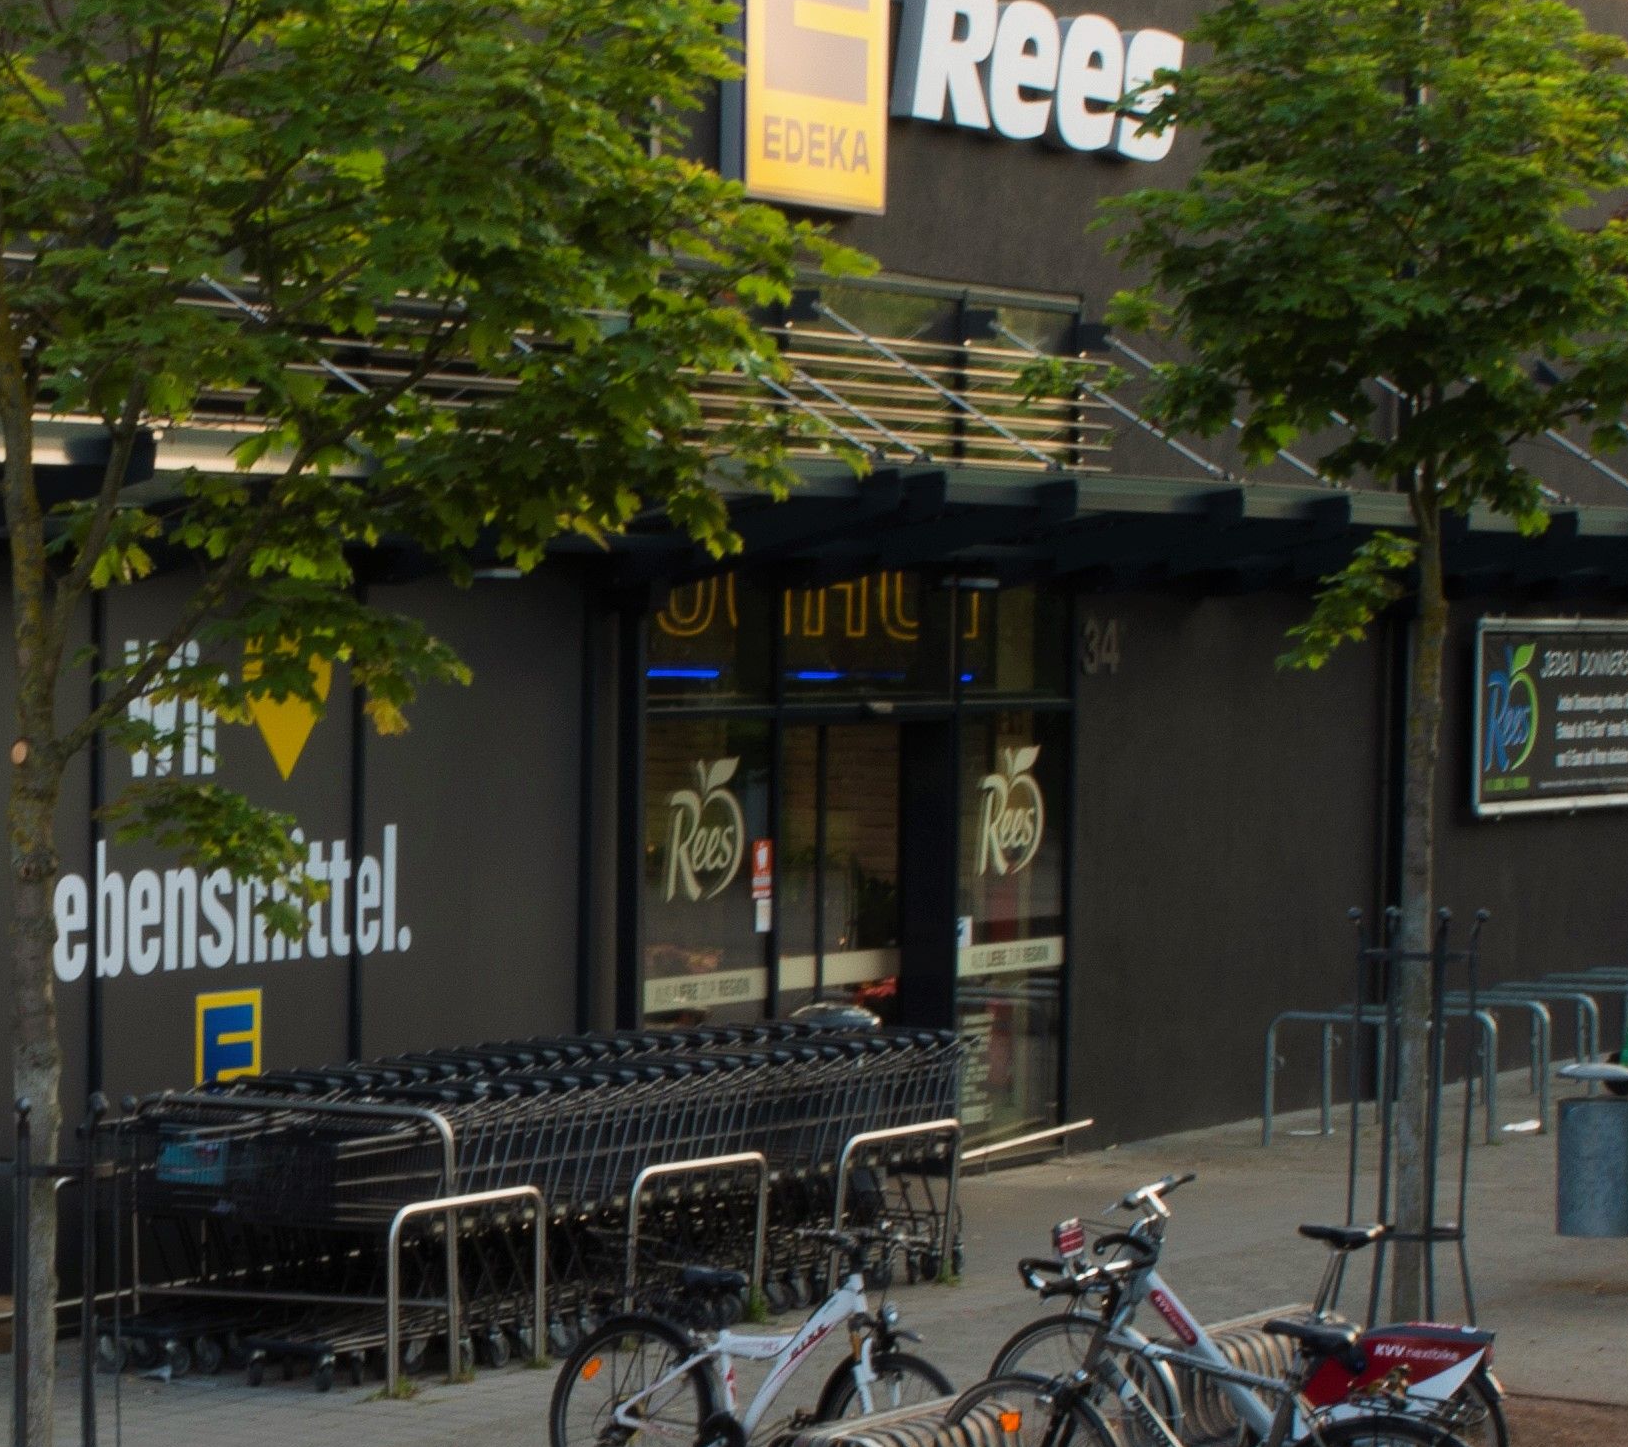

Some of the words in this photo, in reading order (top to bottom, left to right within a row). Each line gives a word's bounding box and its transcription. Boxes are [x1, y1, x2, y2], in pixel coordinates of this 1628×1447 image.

[760, 113, 872, 176] EDEKA
[1081, 617, 1121, 675] 34
[665, 789, 738, 903] Rees
[978, 773, 1038, 877] Rees
[52, 823, 412, 984] ebensmittel.
[1374, 1342, 1406, 1358] KVV
